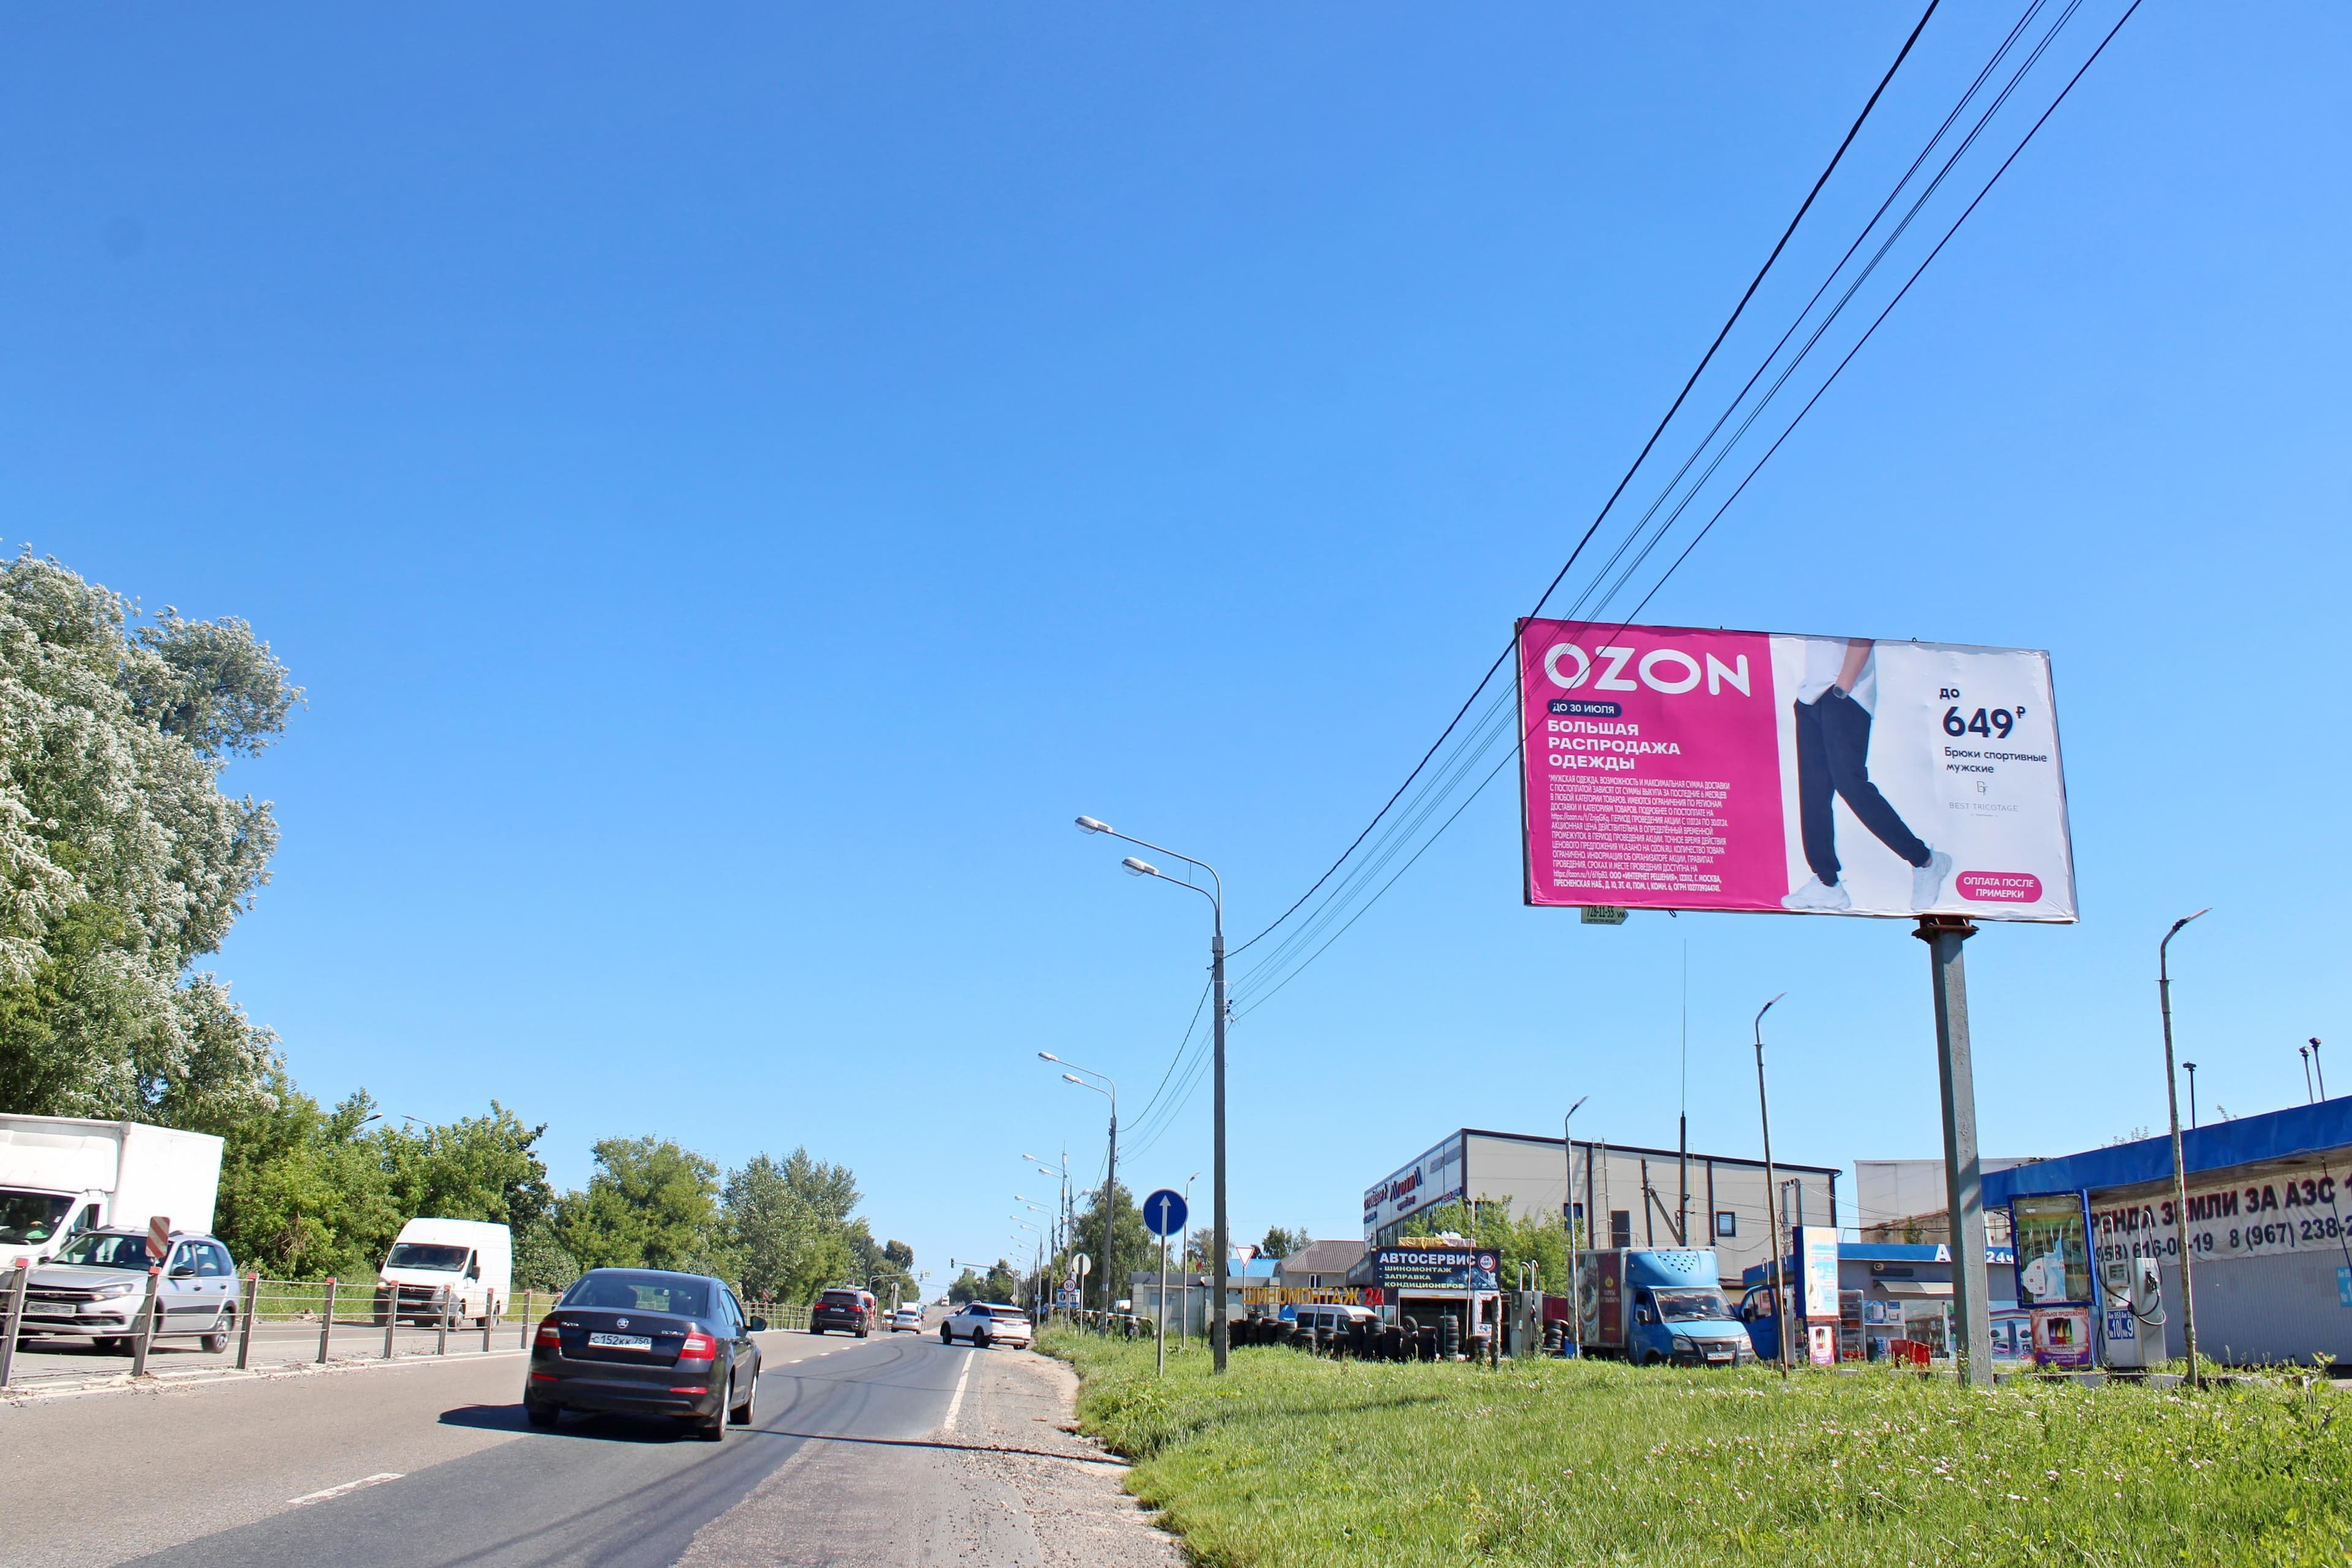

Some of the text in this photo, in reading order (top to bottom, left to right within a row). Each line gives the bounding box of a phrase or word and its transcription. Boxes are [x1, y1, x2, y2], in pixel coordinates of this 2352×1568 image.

[1544, 643, 1751, 697] OZON
[1552, 703, 1615, 714] ДО 30 ИЮЛЯ
[1547, 719, 1638, 736] БОЛЬШАЯ
[1548, 737, 1681, 755] РАСПРОДАЖА
[1945, 747, 2047, 762] Брюки спортивные
[1548, 754, 1635, 771] ОДЕЖДЫ
[1946, 764, 1994, 773] мужские
[1600, 777, 1638, 786] ВОЗМОЖНОСТЬ
[1644, 779, 1685, 788] МАКСИМАЛЬНАЯ
[1686, 780, 1703, 789] СУММА
[1705, 781, 1730, 790] ДОСТАВКИ
[1555, 783, 1591, 793] ПОСТОПЛАТОЙ
[1593, 785, 1614, 794] ЗАВИСЯТ
[1670, 790, 1700, 798] ПОСЛЕДНИЕ
[1705, 791, 1726, 799] МЕСЯЦЕВ
[1555, 793, 1574, 802] ЛЮБОЙ
[1652, 798, 1686, 807] ОГРАНИЧЕНИЯ
[1551, 802, 1577, 811] ДОСТАВКИ
[1583, 804, 1613, 813] КАТЕГОРИЯМ
[1615, 805, 1637, 814] ТОВАРОВ.
[1639, 806, 1667, 815] ПОДРОБНЕЕ
[1674, 808, 1705, 816] ПОСТОПЛАТЕ
[1973, 803, 2018, 812] TRICOTAGE
[1611, 815, 1630, 823] ПЕРИОД
[1632, 815, 1662, 825] ПРОВЕДЕНИЯ
[1598, 823, 1638, 832] ДЕЙСТВИТЕЛЬНА
[1684, 826, 1713, 835] ВРЕМЕННОЙ
[1552, 831, 1587, 840] ПРОМЕЖУТОК
[1593, 832, 1612, 841] ПЕРИОД
[1613, 833, 1645, 842] ПРОВЕДЕНИЯ
[1702, 836, 1726, 845] ДЕЙСТВИЯ
[1581, 842, 1618, 850] ПРЕДЛОЖЕНИЯ
[1673, 845, 1705, 854] КОЛИЧЕСТВО
[1588, 851, 1623, 861] ИНФОРМАЦИЯ
[1632, 853, 1668, 862] ОРГАНИЗАТОРЕ
[1687, 855, 1713, 864] ПРАВИЛАХ
[1553, 859, 1586, 869] ПРОВЕДЕНИЯ,
[1630, 862, 1662, 871] ПРОВЕДЕНИЯ
[1663, 864, 1689, 872] ДОСТУПНА
[1554, 880, 1591, 888] ПРЕСНЕНСКАЯ
[1592, 881, 1604, 889] НАБ.,
[1623, 872, 1649, 881] «ИНТЕРНЕТ
[1651, 873, 1678, 882] РЕШЕНИЯ»,
[1699, 875, 1721, 884] МОСКВА,
[1963, 876, 2034, 887] ОПЛАТА ПОСЛЕ
[1975, 889, 2024, 898] ПРИМЕРКИ
[2090, 1205, 2156, 1235] РЕНДА
[2244, 1184, 2278, 1213] ЗА
[2285, 1176, 2335, 1208] АЗС
[2230, 1228, 2239, 1248] 8
[2245, 1222, 2294, 1251] (967)
[1379, 1253, 1476, 1265] АВТОСЕРВИС
[1242, 1287, 1383, 1305] ШИНОМОНТАЖ 24
[2113, 1319, 2120, 1337] 10
[2127, 1319, 2133, 1337] 9
